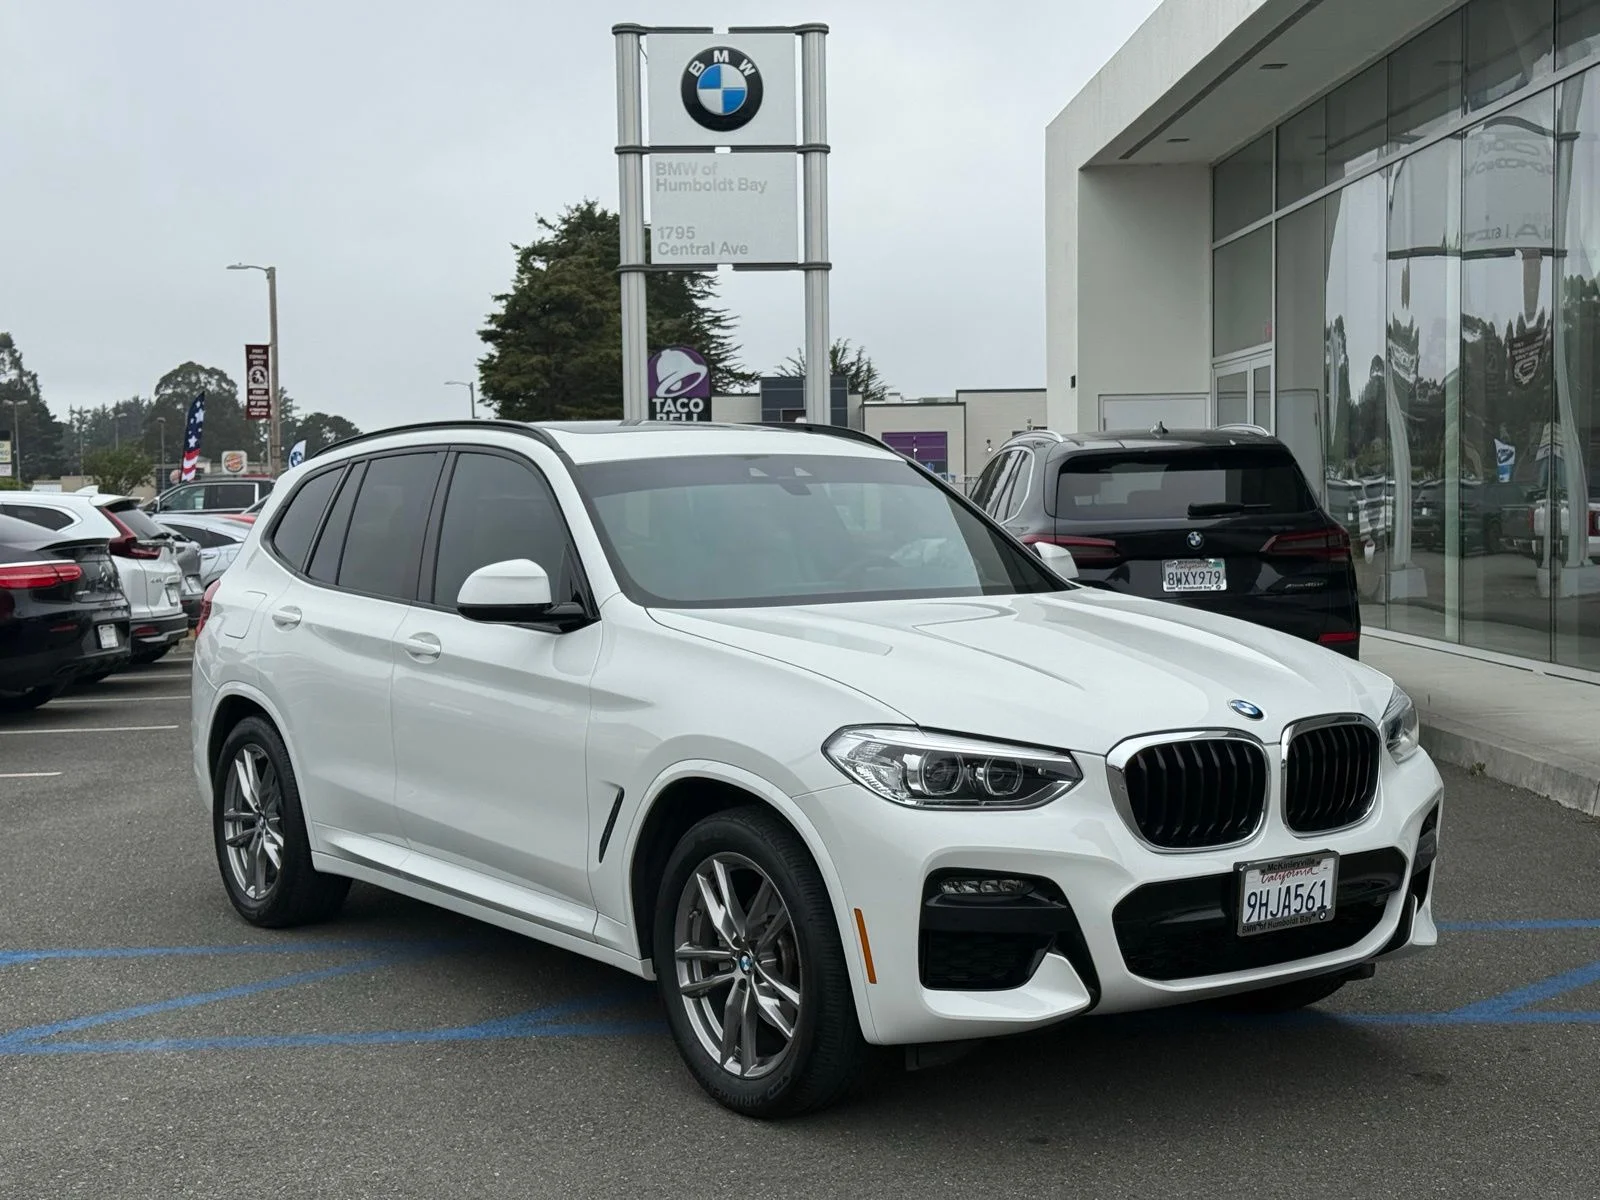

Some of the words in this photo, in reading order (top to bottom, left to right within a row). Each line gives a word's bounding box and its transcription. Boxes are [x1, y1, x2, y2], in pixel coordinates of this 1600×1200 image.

[688, 50, 756, 78] BMW
[655, 161, 698, 176] BMW
[702, 161, 718, 176] of
[655, 178, 734, 192] Humboldt
[737, 177, 768, 194] Bay
[657, 226, 696, 240] 1795
[657, 241, 715, 255] Central
[719, 241, 748, 255] Ave
[652, 398, 704, 413] TACO
[1167, 571, 1221, 586] 8WXY979
[1261, 867, 1318, 885] California
[1246, 880, 1327, 922] 9HJA561
